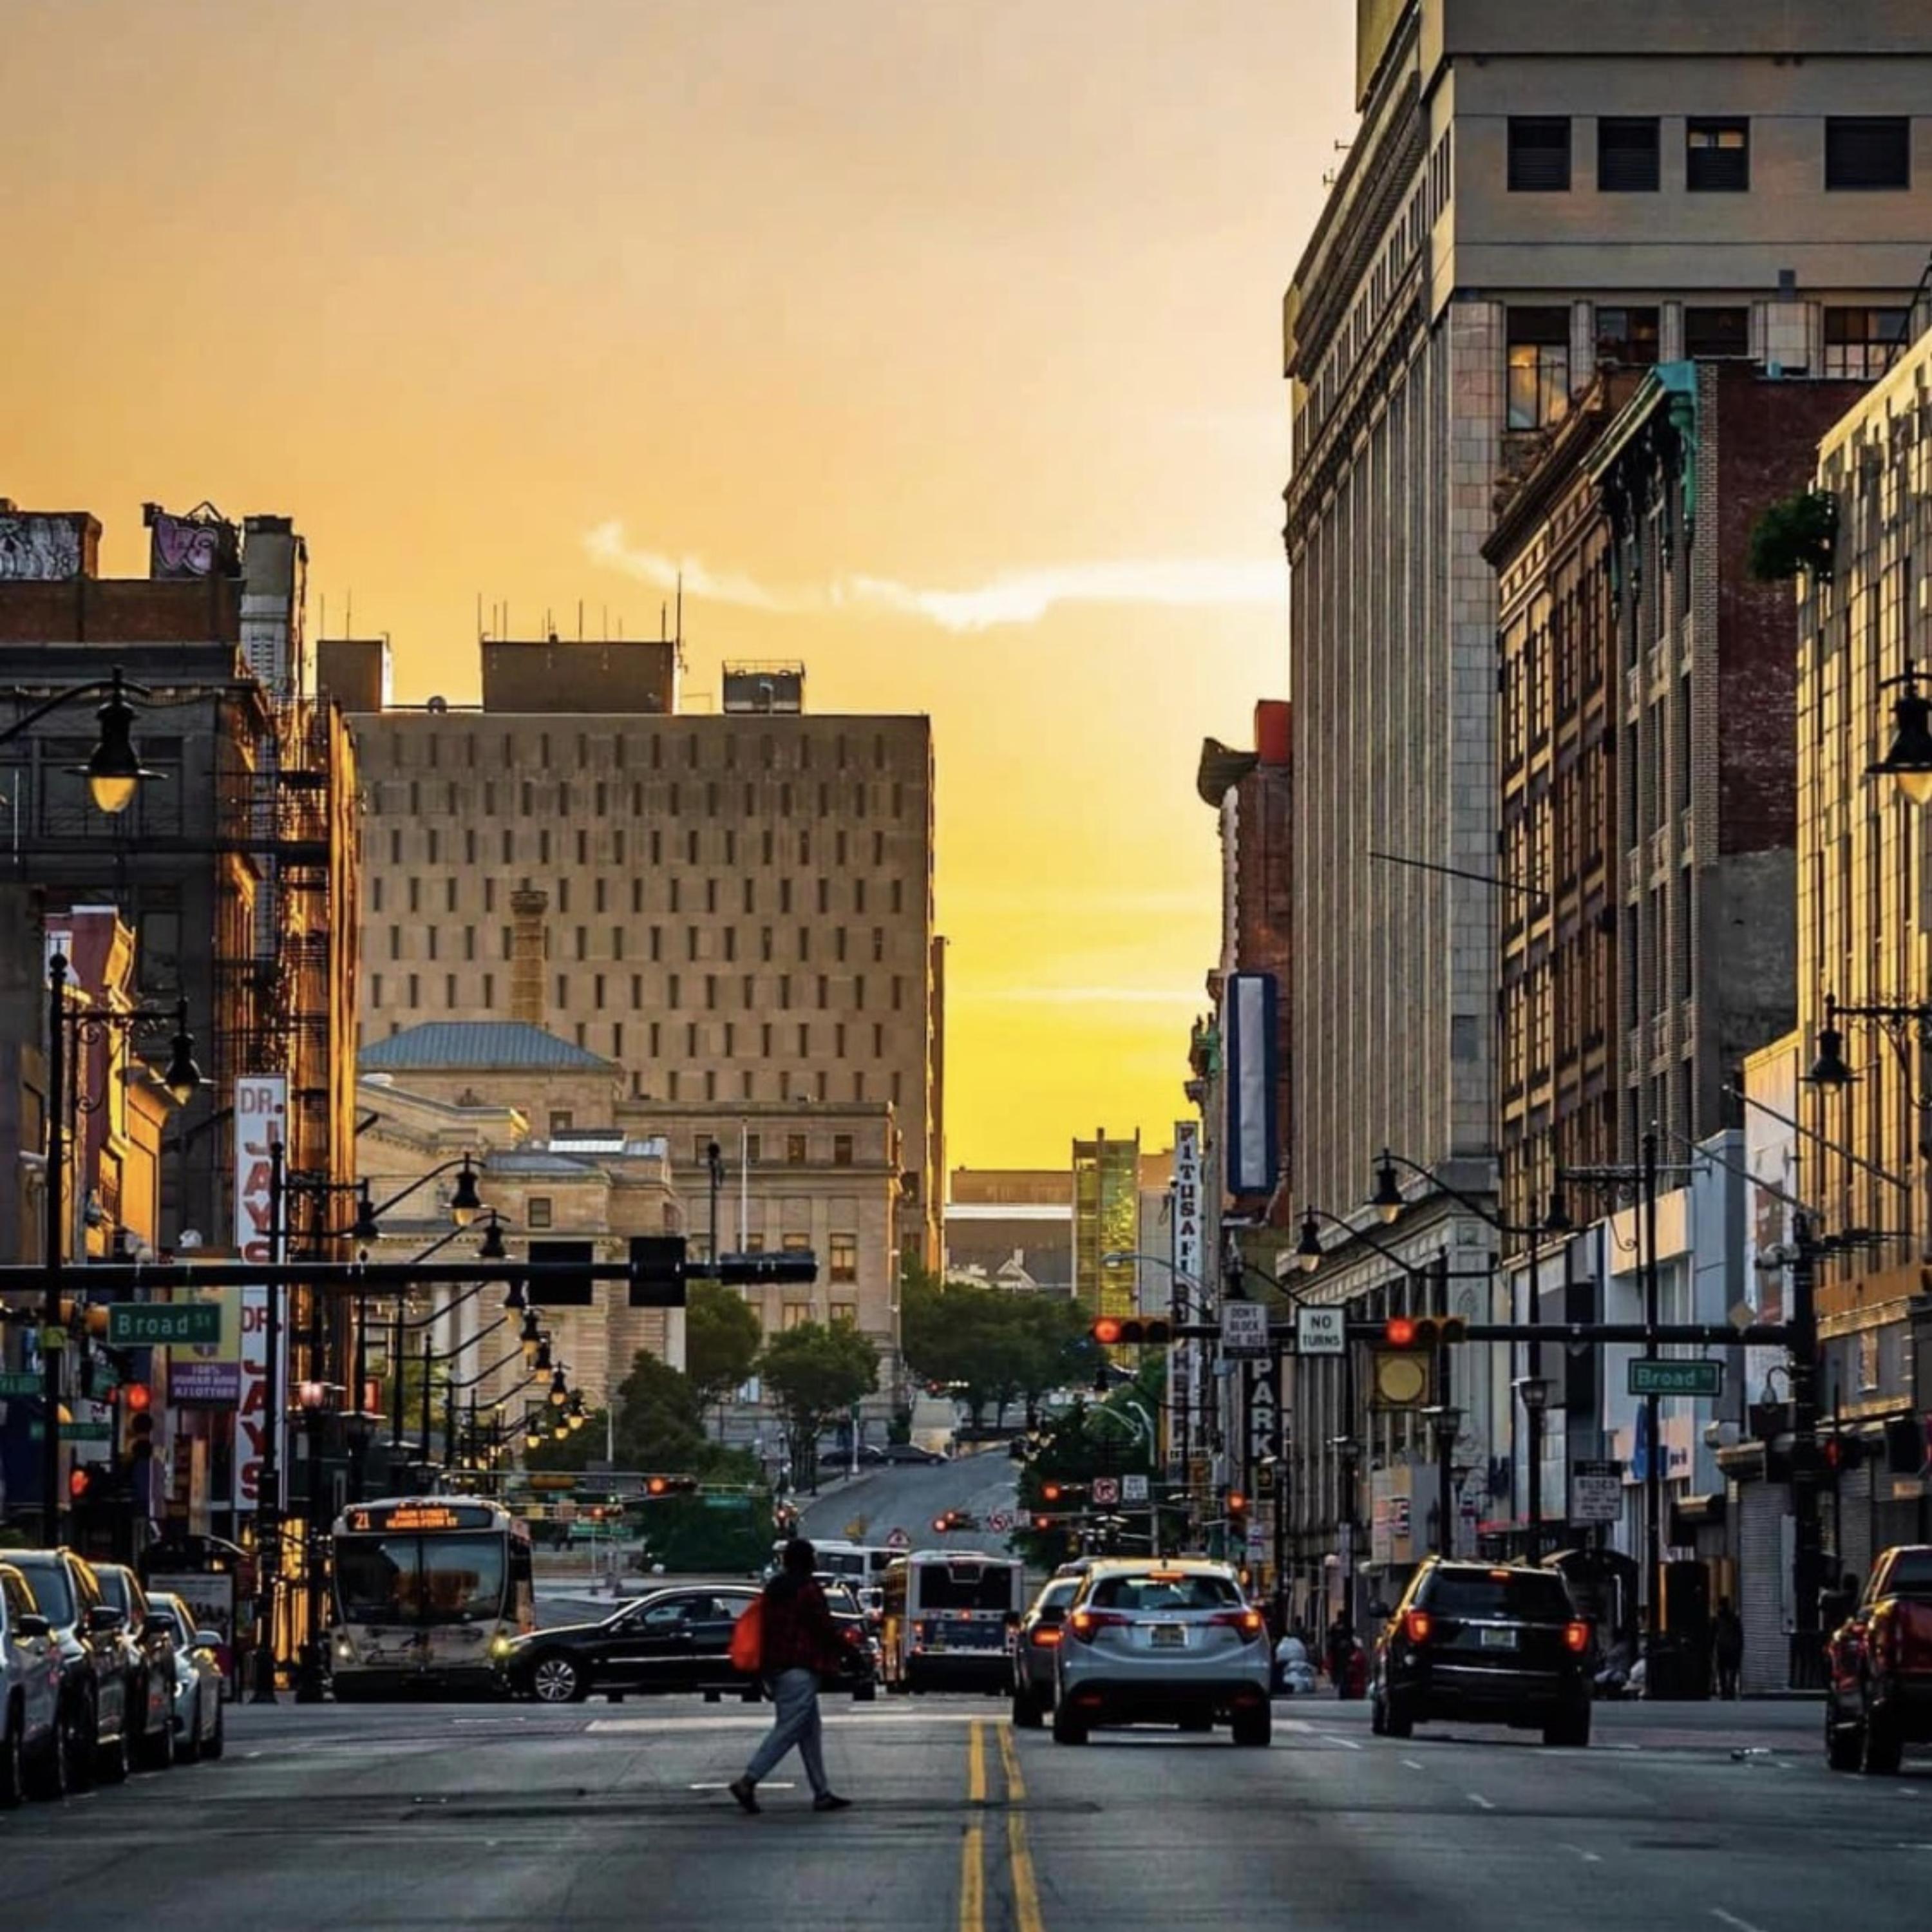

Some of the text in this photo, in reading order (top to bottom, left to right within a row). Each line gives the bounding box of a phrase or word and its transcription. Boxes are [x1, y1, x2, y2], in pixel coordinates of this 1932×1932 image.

[240, 1087, 283, 1114] DR.
[1180, 1127, 1196, 1236] PITUSA
[118, 1314, 188, 1335] Broad
[1230, 1321, 1258, 1331] BLOCK
[1311, 1315, 1332, 1329] NO
[1303, 1334, 1340, 1347] TURNS
[1638, 1368, 1696, 1386] Broad
[1251, 1358, 1274, 1457] PARK
[355, 1511, 370, 1530] 21
